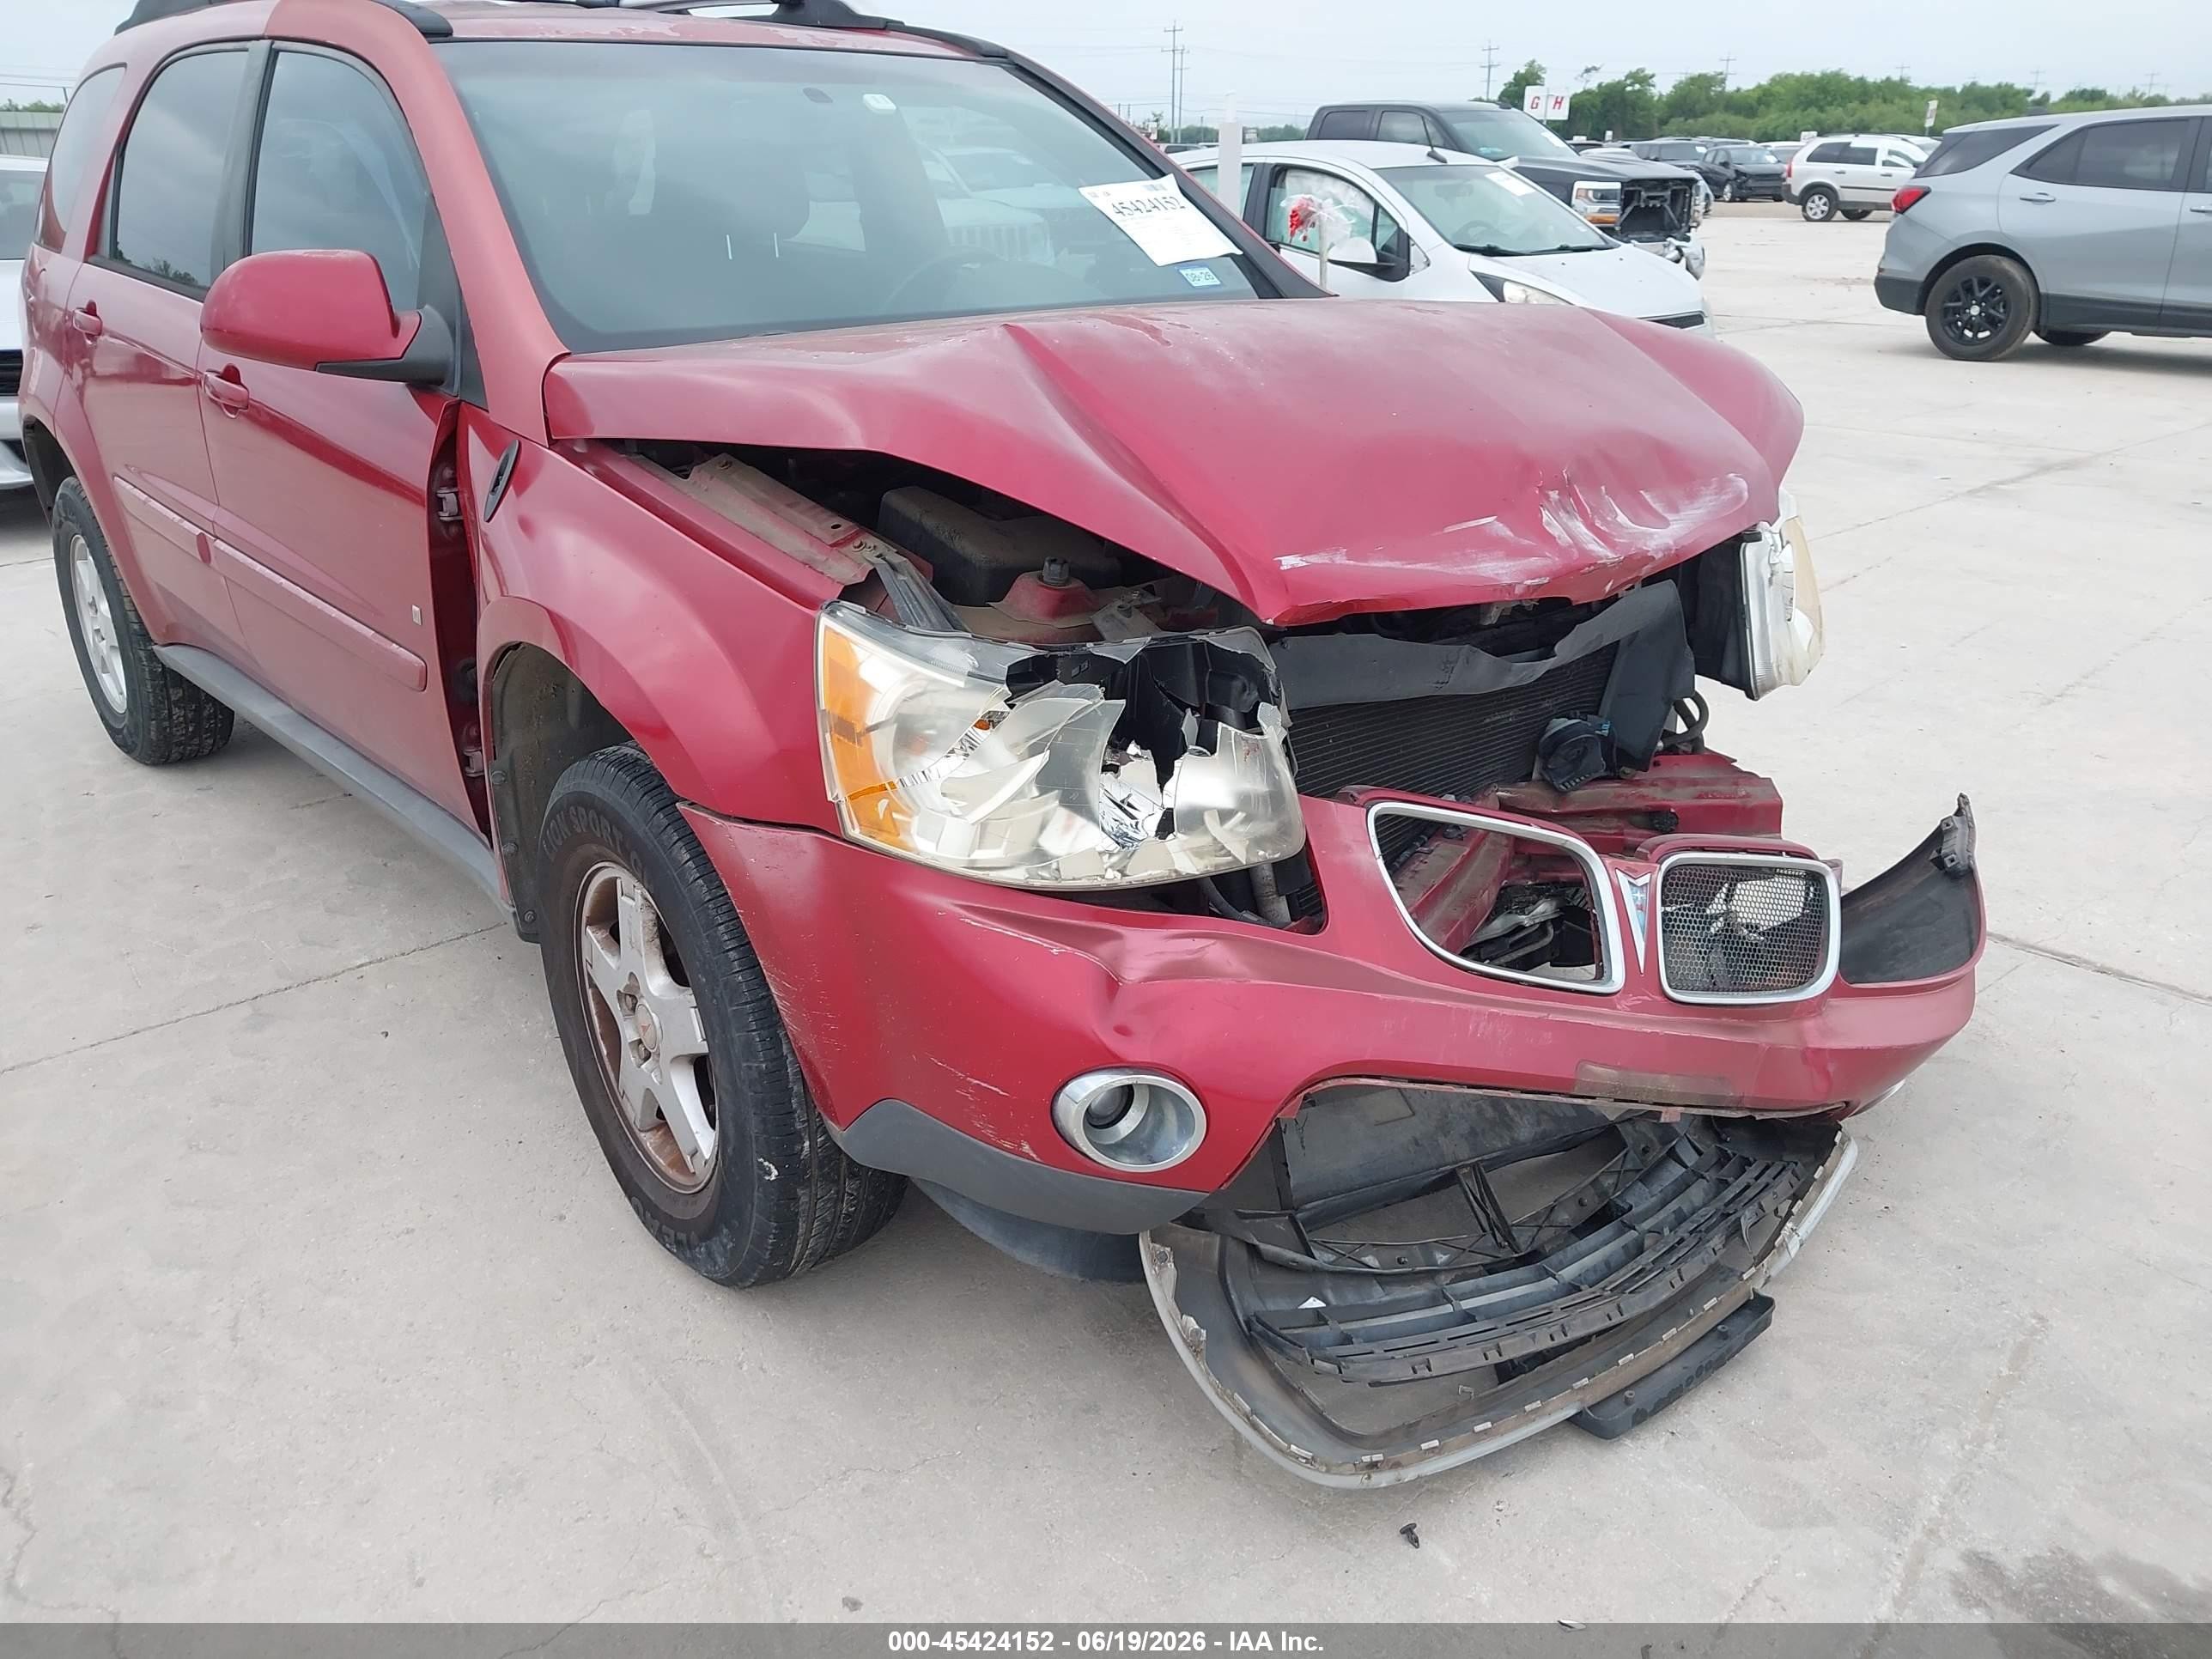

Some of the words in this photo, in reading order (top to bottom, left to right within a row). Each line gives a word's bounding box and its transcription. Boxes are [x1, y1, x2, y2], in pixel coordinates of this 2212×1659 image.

[1530, 95, 1540, 110] G
[1552, 95, 1565, 110] H
[1111, 196, 1186, 216] 45424152
[569, 805, 625, 857] SPORT
